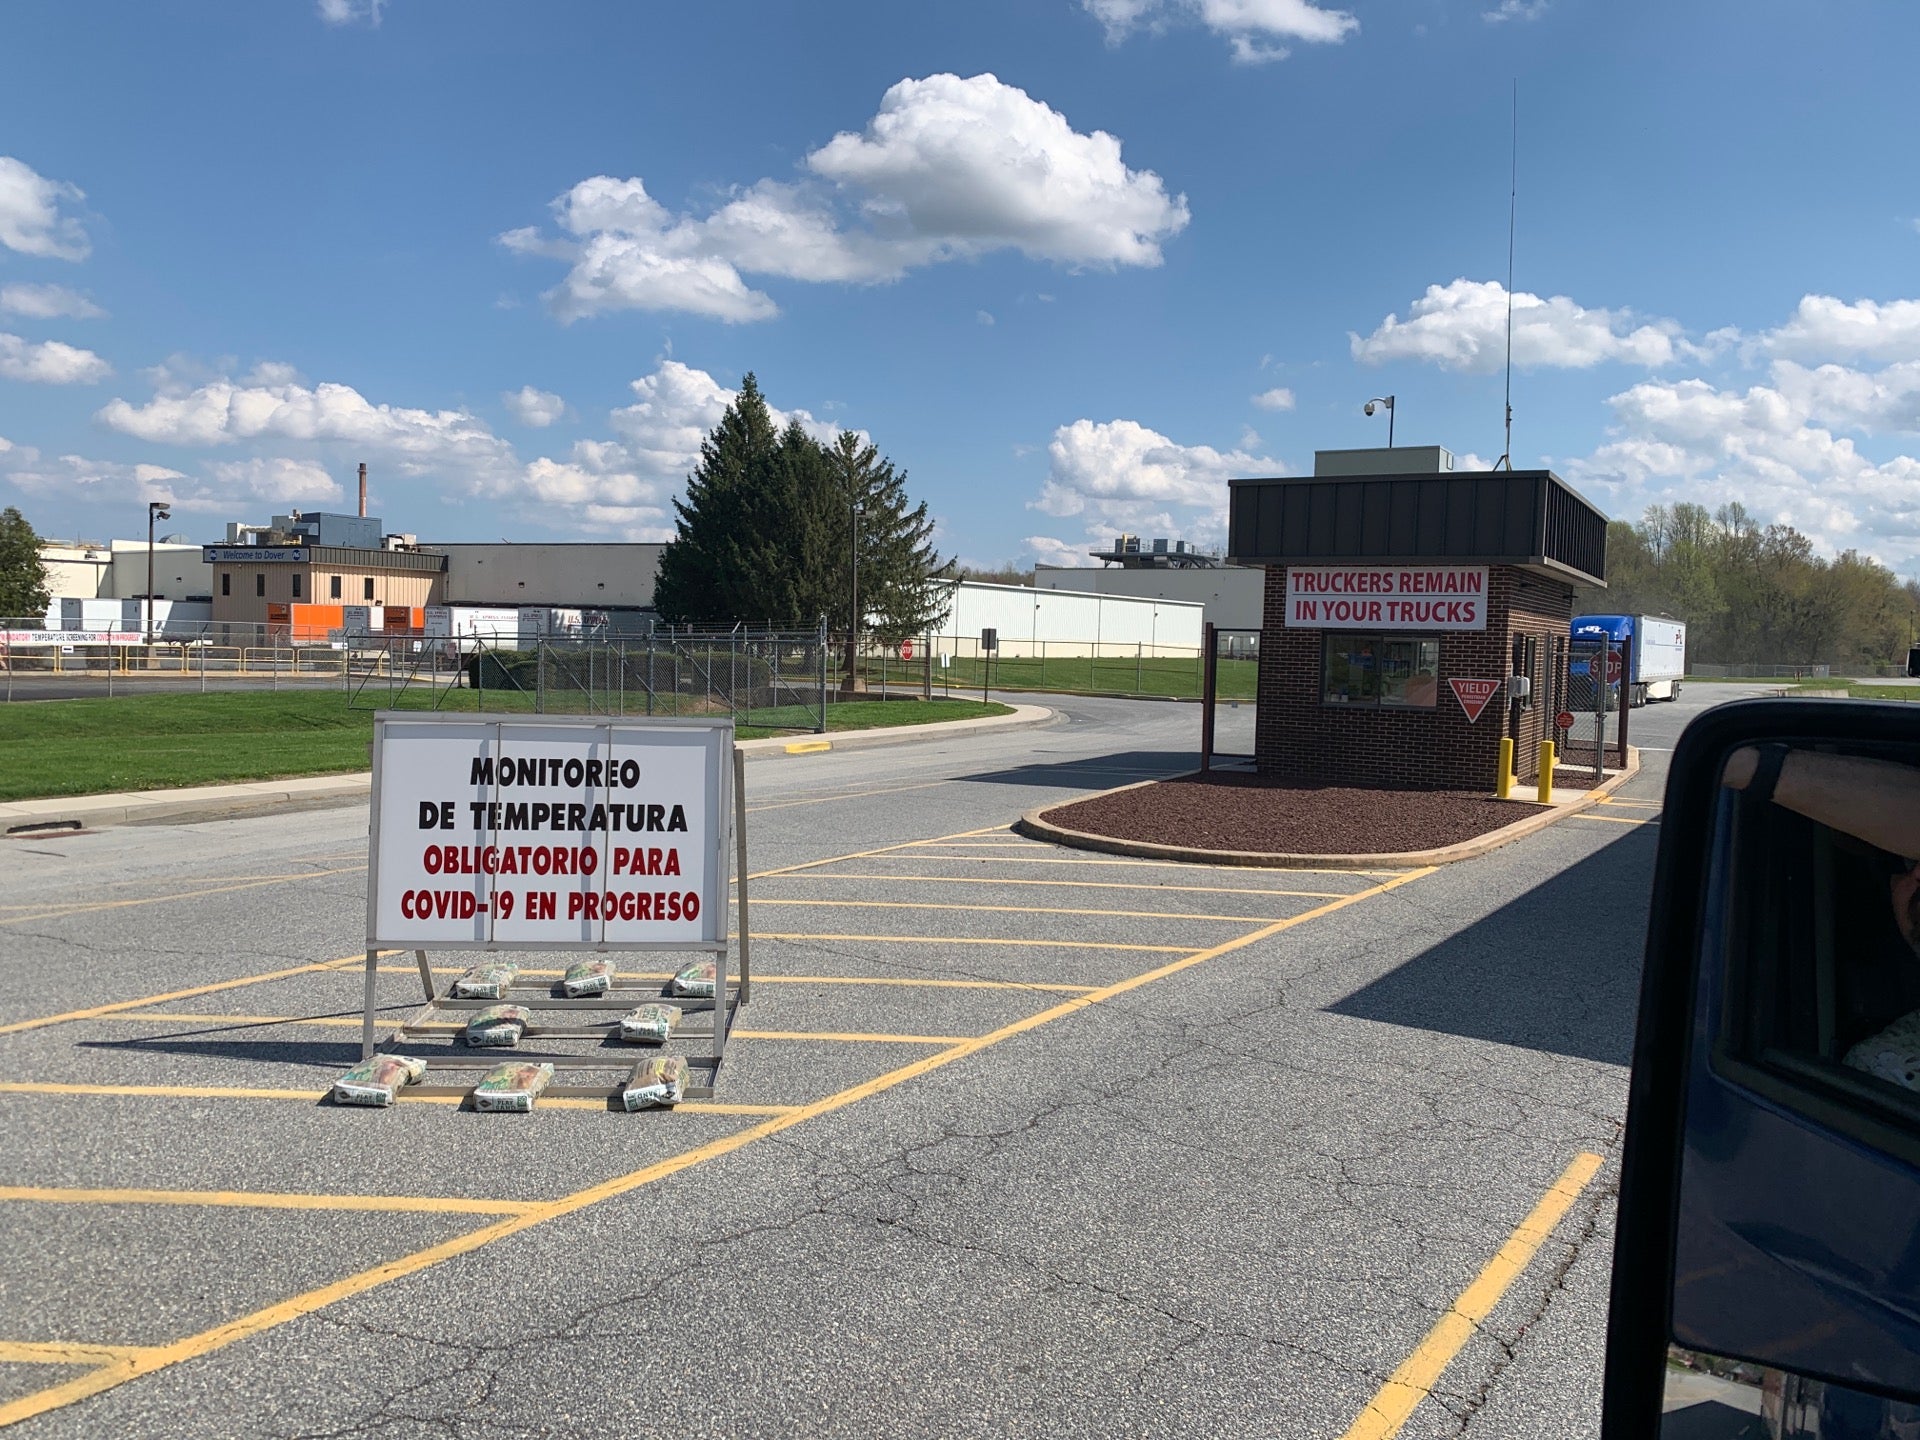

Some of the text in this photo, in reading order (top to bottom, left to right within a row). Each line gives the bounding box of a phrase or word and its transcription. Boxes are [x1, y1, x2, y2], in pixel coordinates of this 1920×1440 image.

[223, 550, 253, 559] Welcome
[255, 551, 262, 559] to
[264, 550, 285, 559] Dover
[1292, 572, 1482, 593] TRUCKERS REMAIN
[1295, 601, 1475, 622] IN YOUR TRUCKS
[32, 633, 65, 641] TEMPERATURE
[1592, 661, 1622, 674] SOP
[1459, 682, 1490, 694] YIELD
[470, 757, 641, 789] MONITOREO
[418, 801, 688, 832] DE TEMPERATURA
[423, 845, 681, 876] OBLIGATORIO PARA
[401, 889, 700, 921] COVID-19 EN PROGRESO
